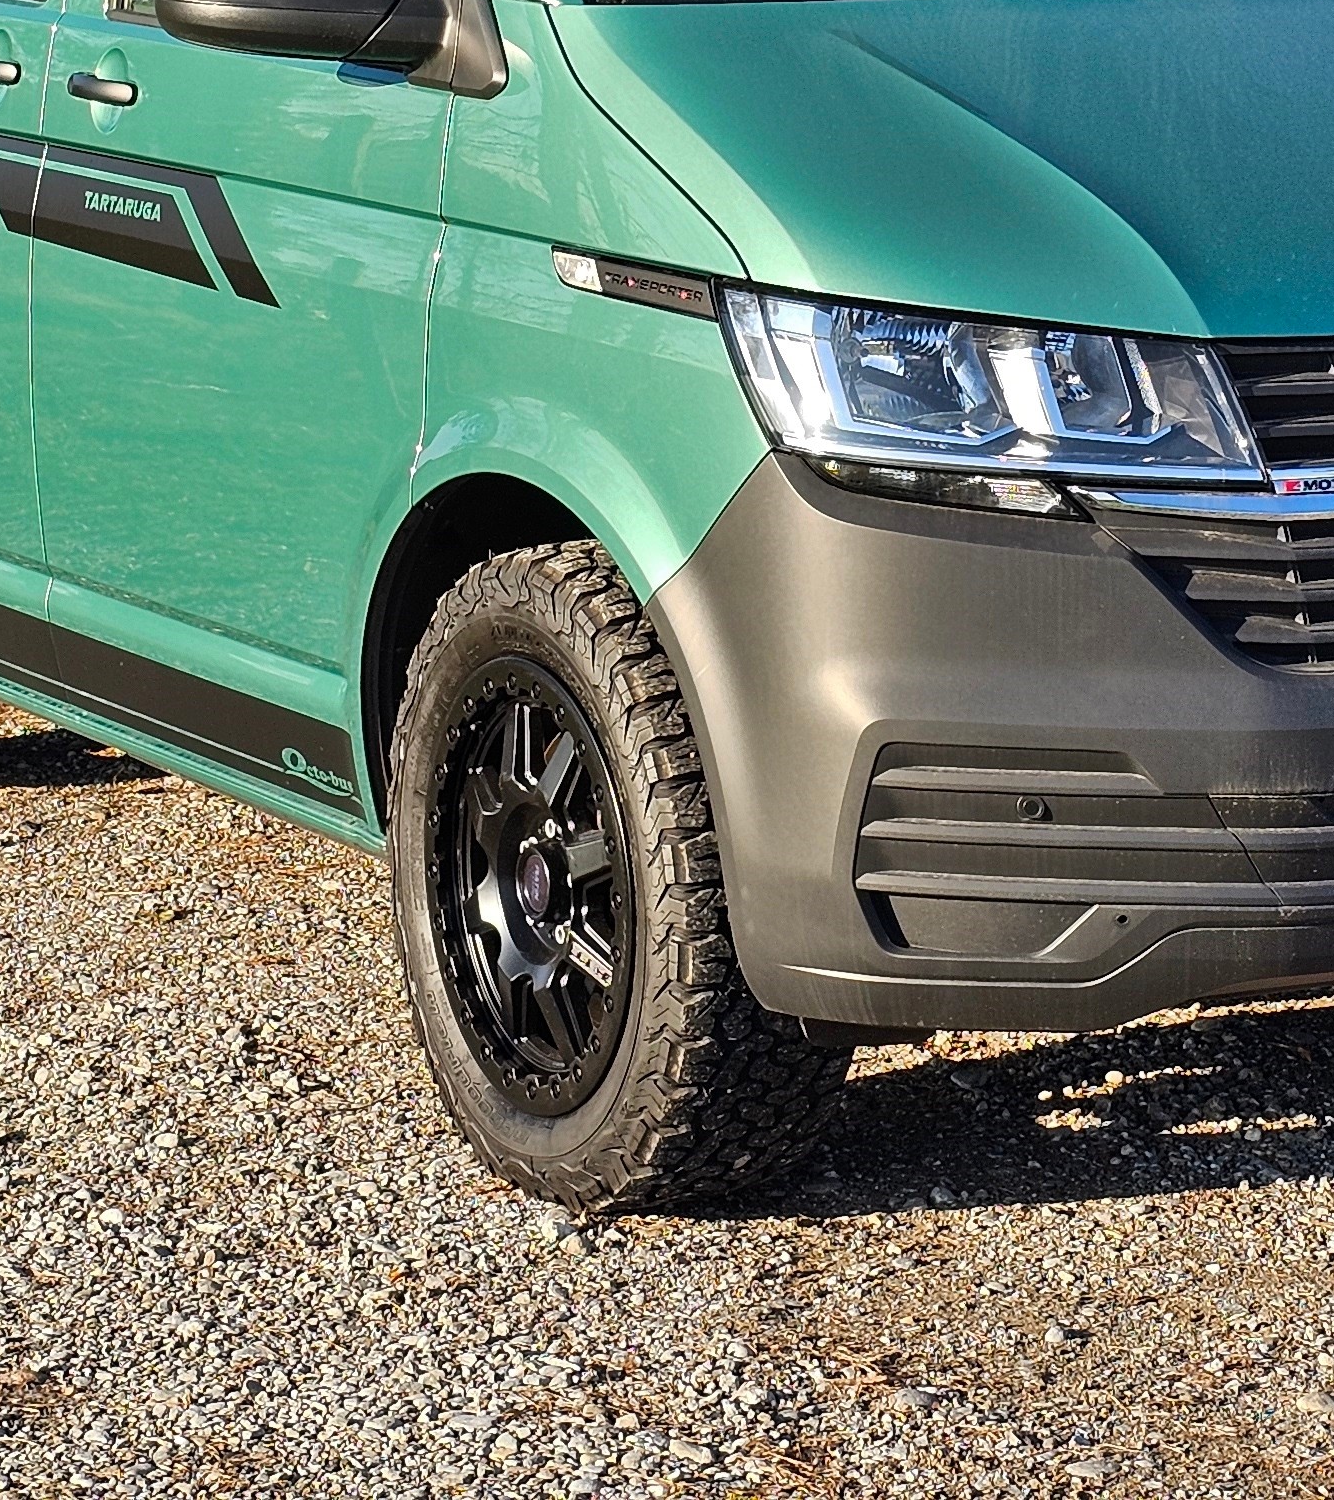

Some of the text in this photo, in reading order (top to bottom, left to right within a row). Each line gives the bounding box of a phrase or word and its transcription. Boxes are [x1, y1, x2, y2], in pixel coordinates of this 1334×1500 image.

[84, 190, 161, 222] TARTARUGA
[605, 271, 703, 303] TRANSPORTER
[281, 747, 354, 794] Octo-bus
